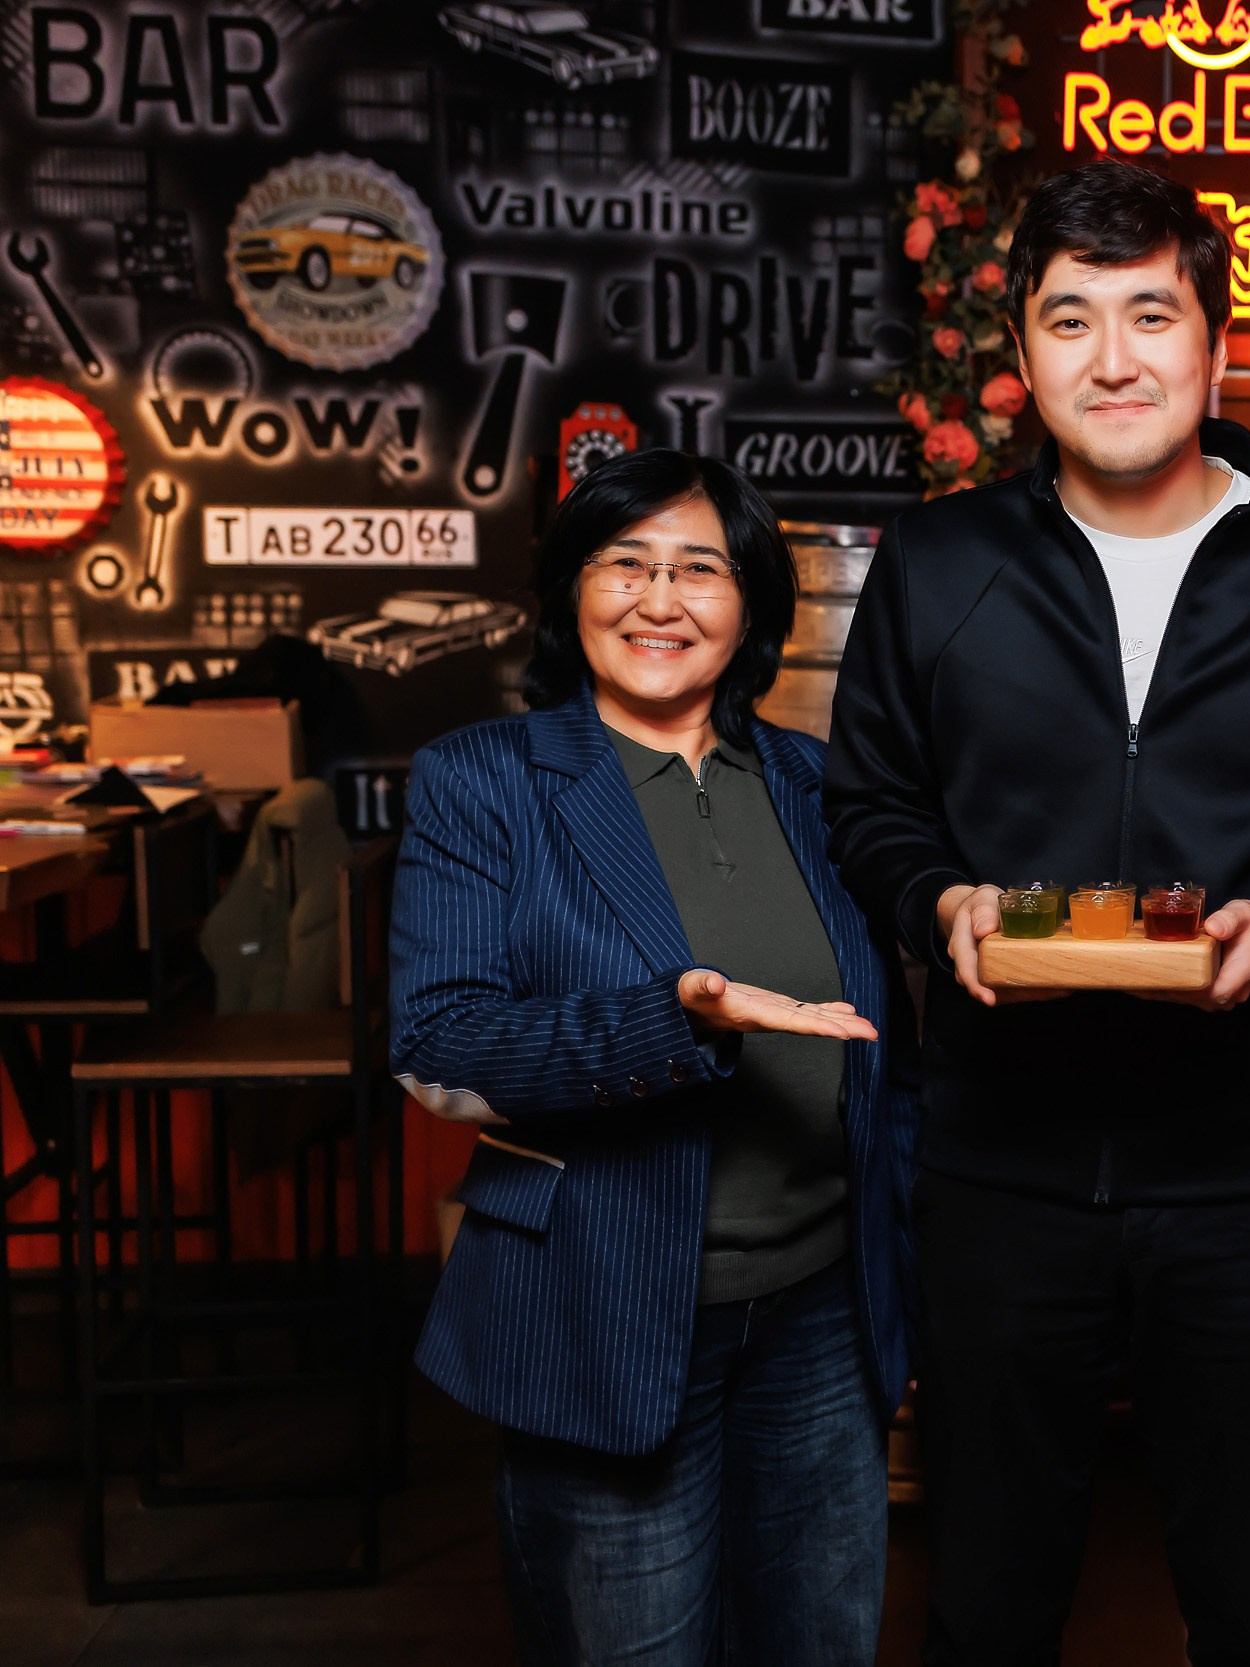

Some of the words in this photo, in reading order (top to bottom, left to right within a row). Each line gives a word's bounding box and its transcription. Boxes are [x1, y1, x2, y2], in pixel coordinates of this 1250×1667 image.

[32, 7, 281, 127] BAR
[688, 74, 832, 151] BOOZE
[1063, 69, 1207, 153] Red
[462, 183, 750, 236] Valvoline
[653, 254, 876, 382] DRIVE
[735, 432, 909, 479] GROOVE
